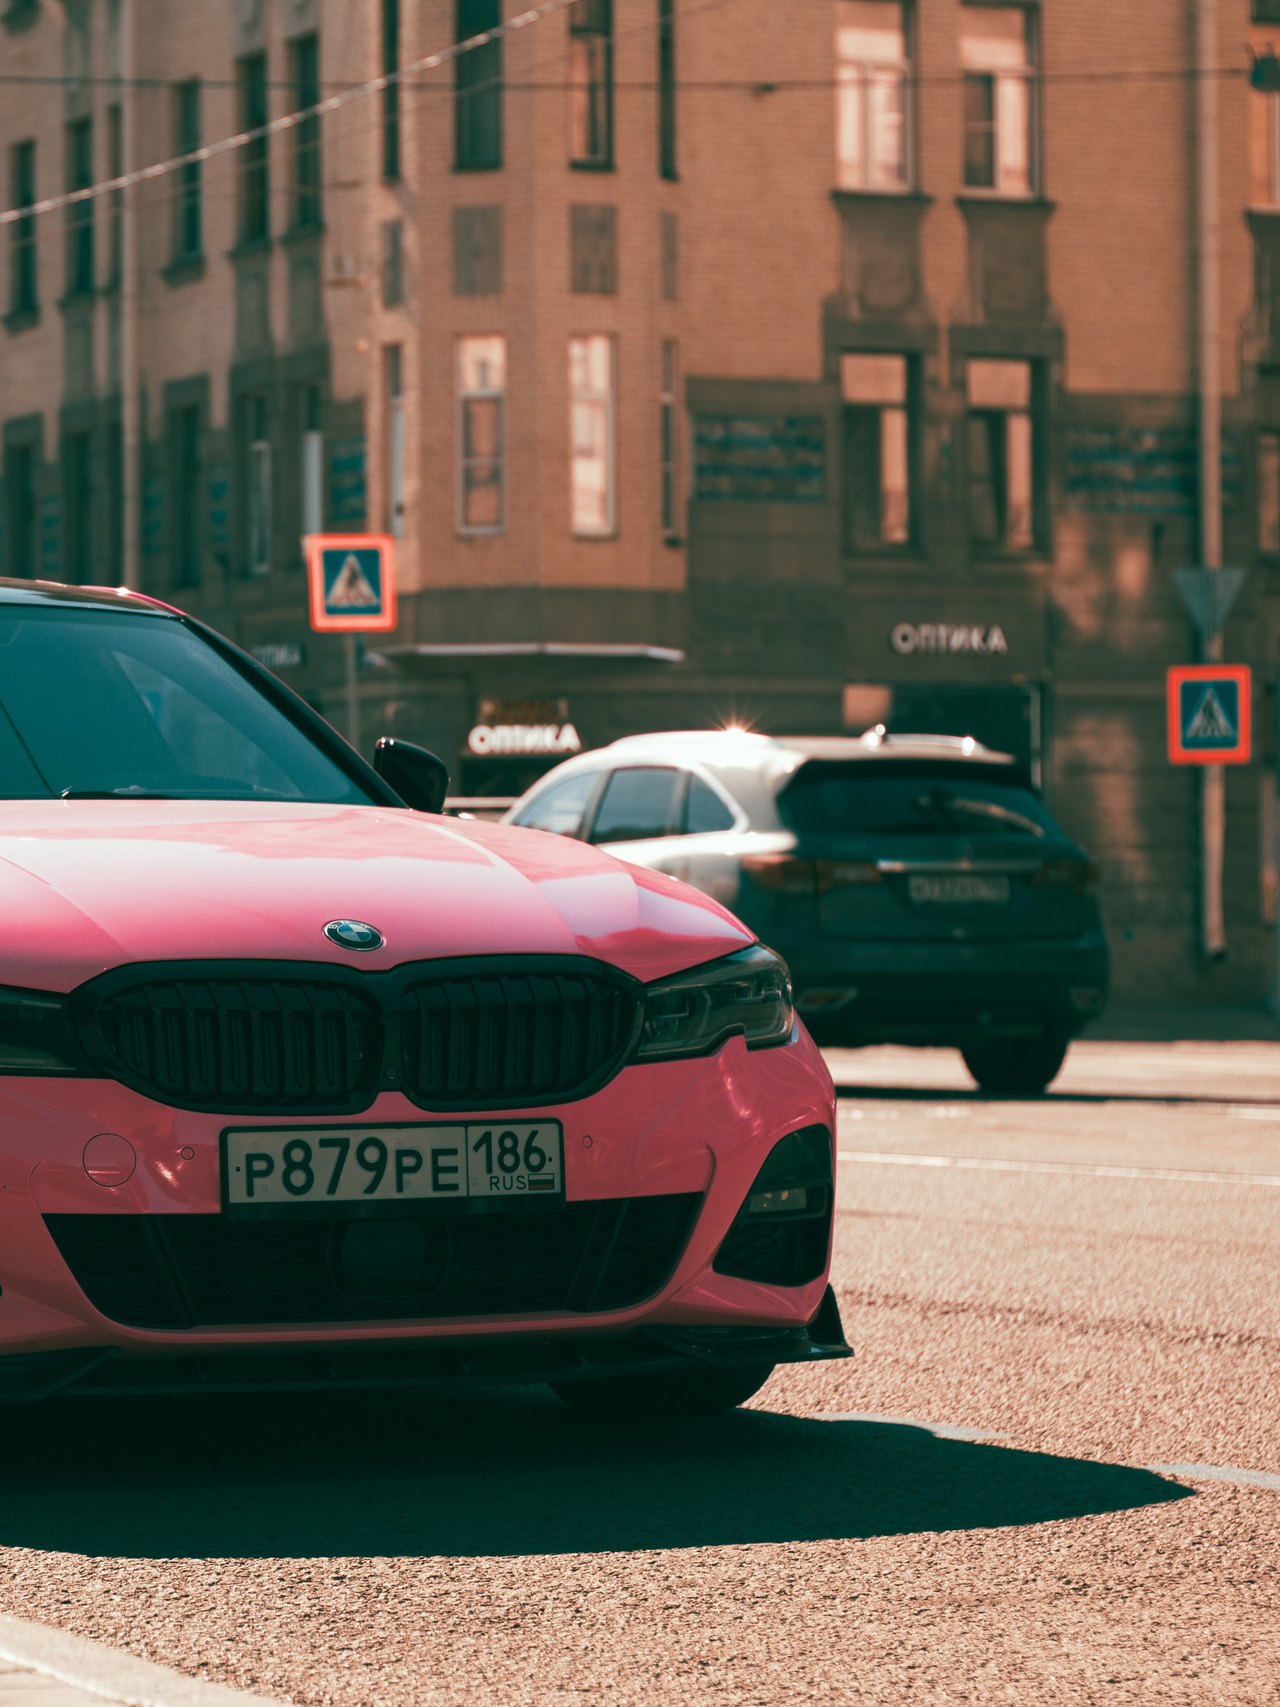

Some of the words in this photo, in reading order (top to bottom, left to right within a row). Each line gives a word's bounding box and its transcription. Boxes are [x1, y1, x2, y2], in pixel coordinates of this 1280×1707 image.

[891, 622, 1009, 655] ОПТИКА
[468, 723, 582, 754] ОПТИКА
[244, 1136, 460, 1198] Р879РЕ
[472, 1129, 547, 1175] 186
[488, 1174, 527, 1192] RUS
